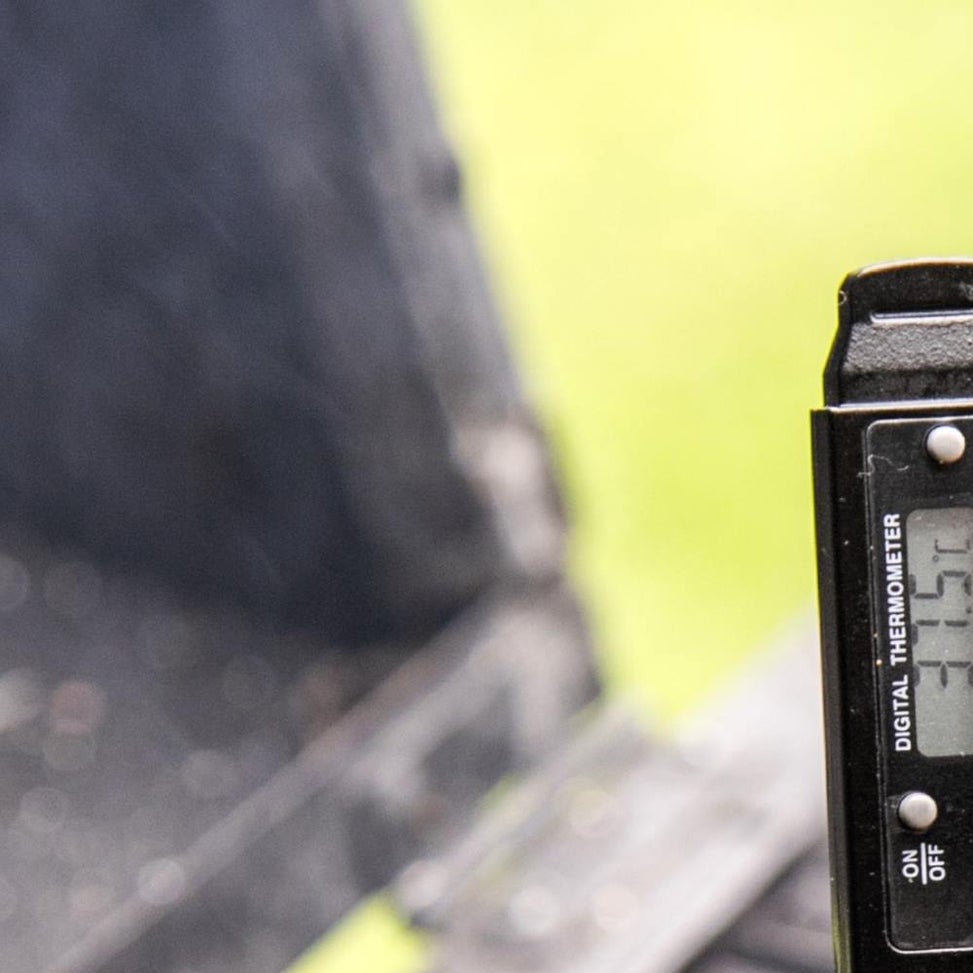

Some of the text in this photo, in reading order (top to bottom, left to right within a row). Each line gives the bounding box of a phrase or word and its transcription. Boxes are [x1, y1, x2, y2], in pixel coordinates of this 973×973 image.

[884, 513, 911, 752] DIGITAL THERMOMETER
[902, 849, 920, 879] ON
[928, 844, 946, 881] OFF
